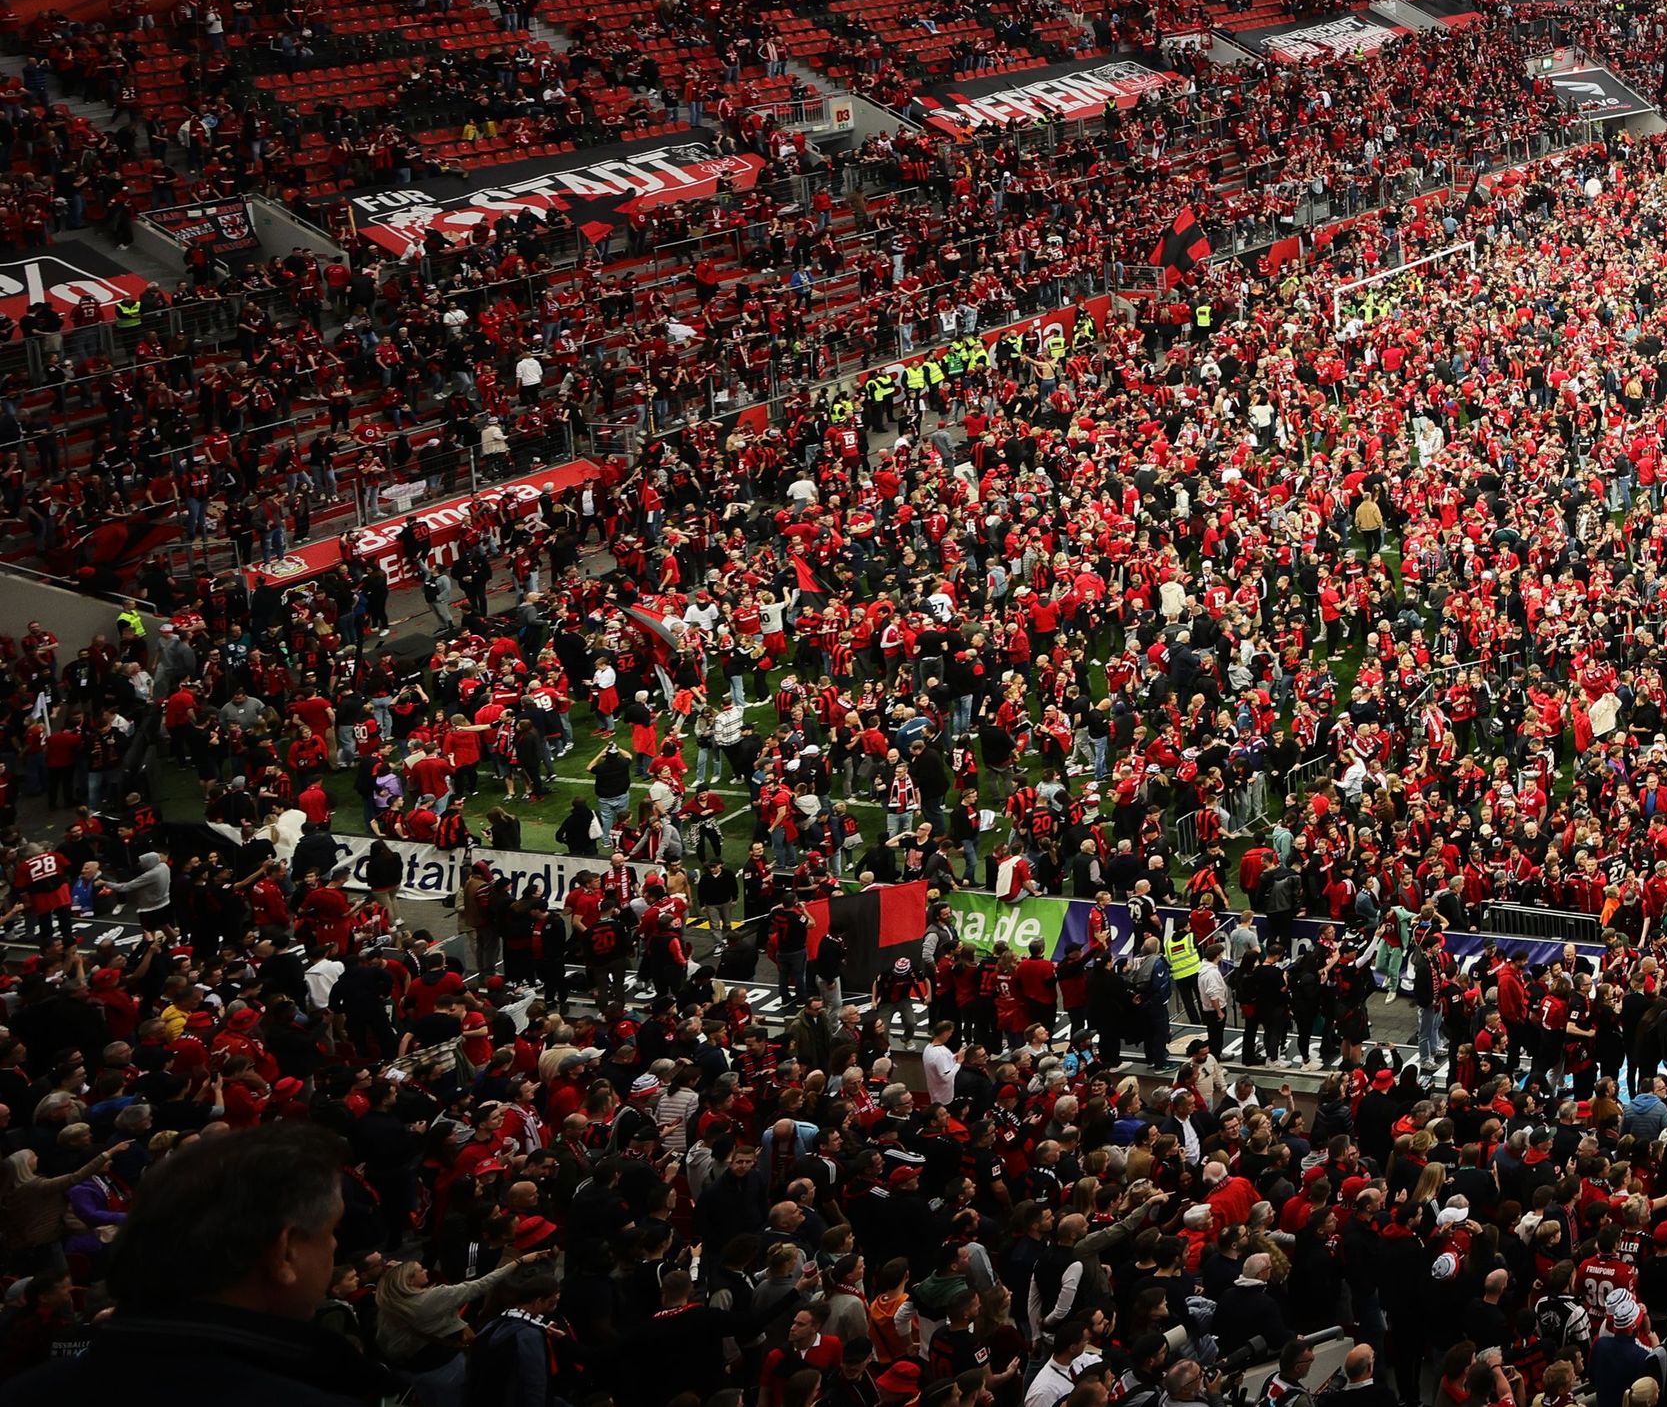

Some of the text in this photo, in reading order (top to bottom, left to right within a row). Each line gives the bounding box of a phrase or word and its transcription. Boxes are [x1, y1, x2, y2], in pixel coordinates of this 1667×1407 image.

[836, 109, 849, 122] D3
[444, 151, 697, 230] STADT
[353, 189, 437, 212] FÜR
[29, 856, 56, 877] 28
[1609, 864, 1625, 881] 27
[1128, 903, 1142, 919] 79
[592, 932, 615, 950] 20
[1586, 1265, 1616, 1276] FRIMPONG
[1585, 1278, 1612, 1307] 30
